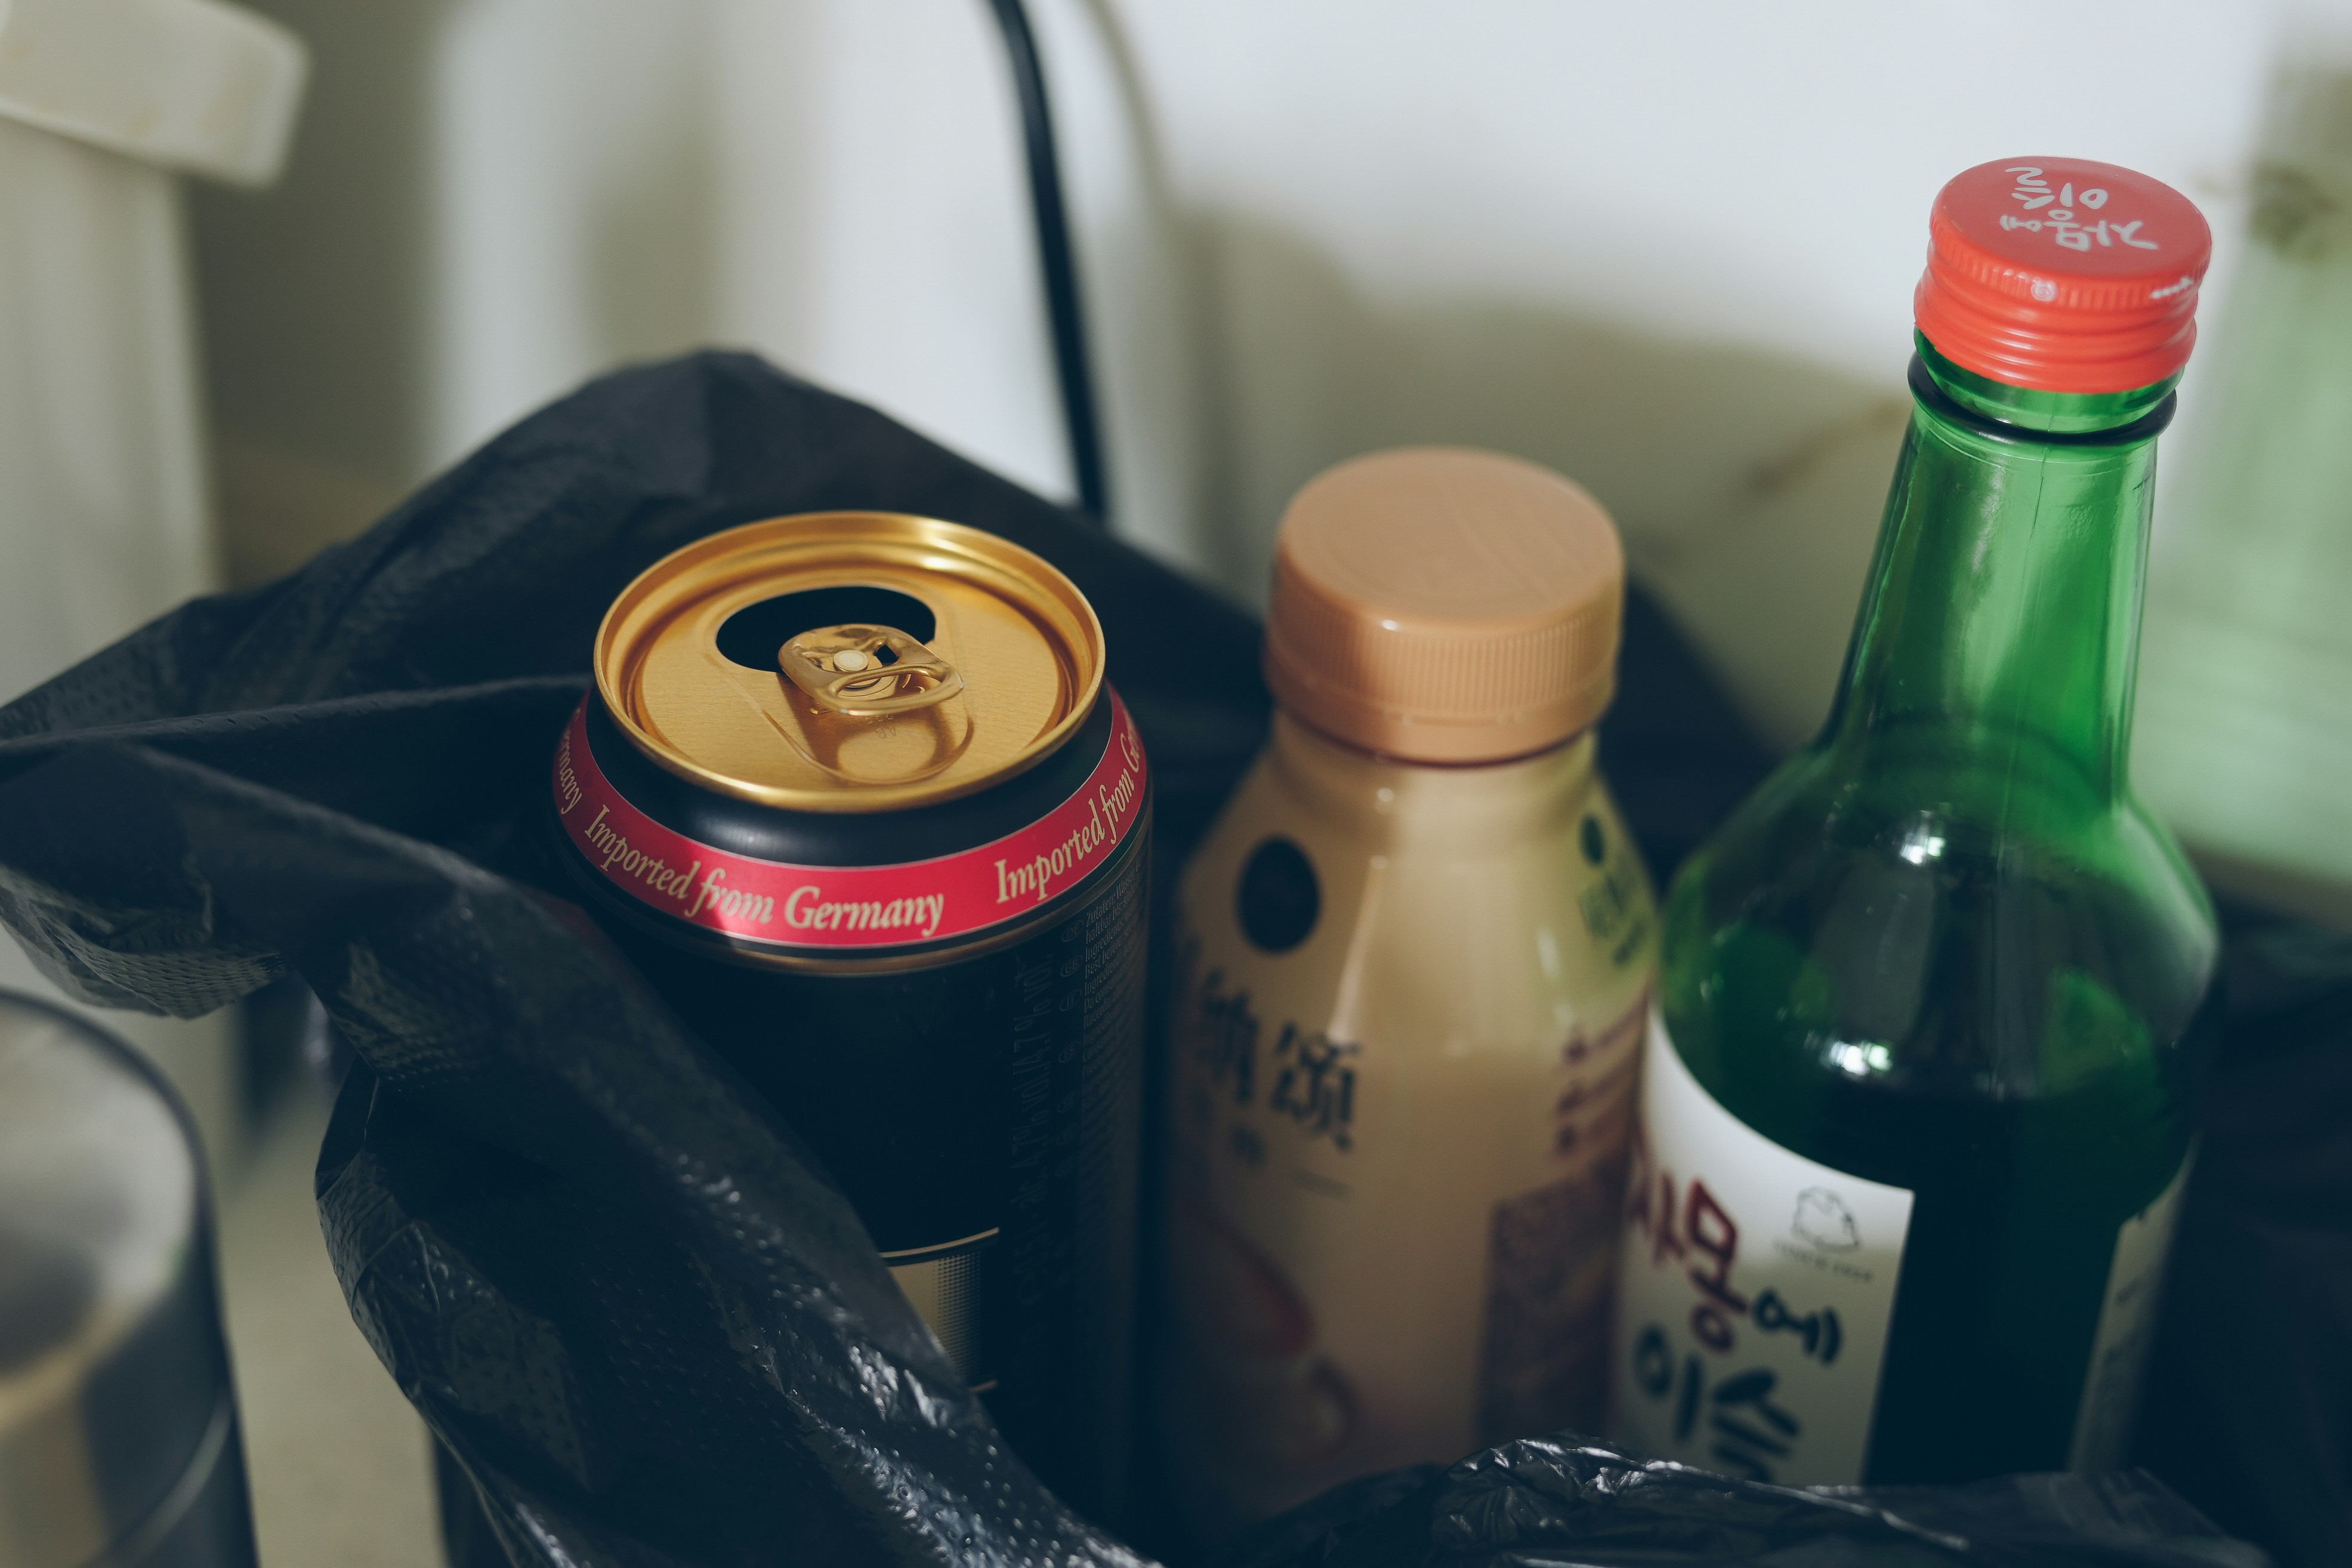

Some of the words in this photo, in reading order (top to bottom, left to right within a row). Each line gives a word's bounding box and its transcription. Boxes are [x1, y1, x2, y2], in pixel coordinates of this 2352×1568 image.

[2000, 209, 2159, 252] 자몽에
[2005, 166, 2107, 210] 이슬
[558, 716, 582, 815] rmany
[584, 804, 702, 900] Imported
[684, 868, 775, 918] from
[785, 885, 945, 937] Germany
[994, 798, 1105, 904] Imported
[1099, 768, 1135, 845] from
